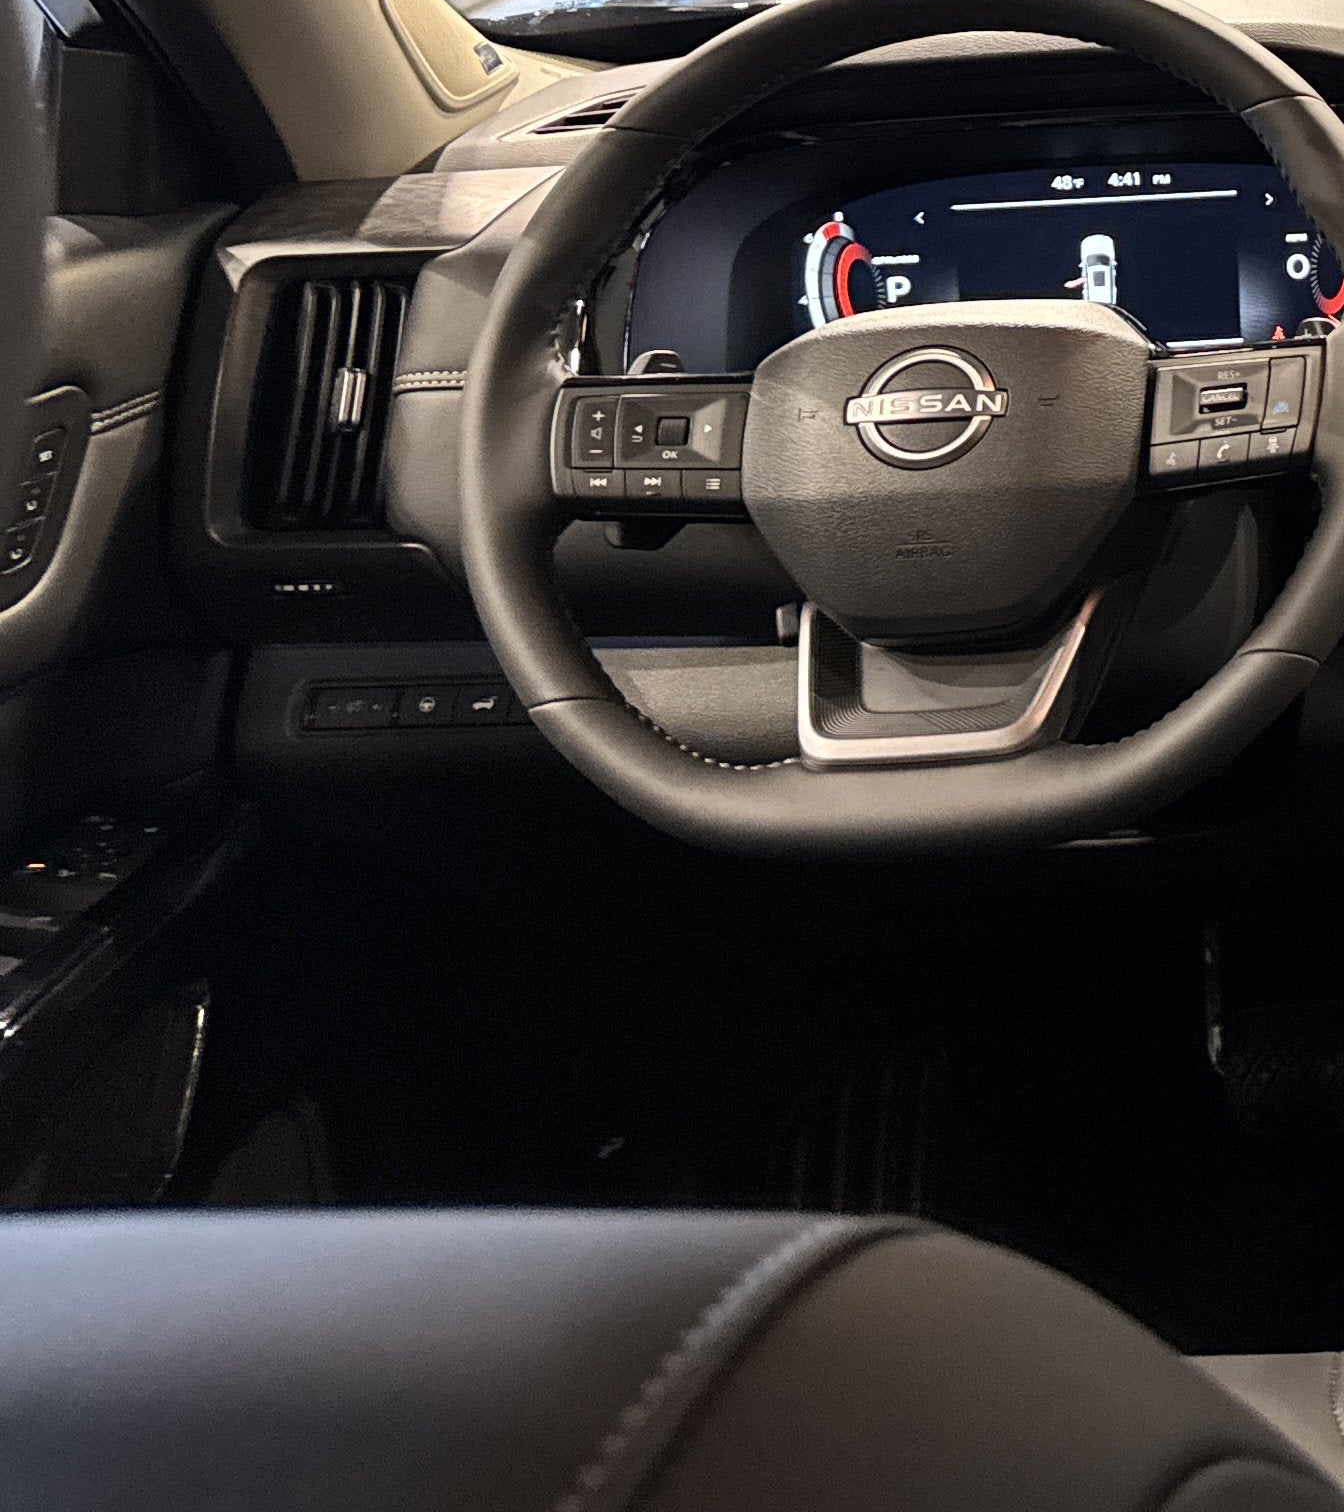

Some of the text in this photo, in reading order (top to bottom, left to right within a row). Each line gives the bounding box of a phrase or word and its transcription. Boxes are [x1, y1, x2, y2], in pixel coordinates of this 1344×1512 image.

[1107, 171, 1171, 187] 4:41 PM
[886, 275, 912, 303] P
[1217, 369, 1242, 381] RES+
[1201, 393, 1241, 403] CANCEL
[852, 393, 1002, 418] NISSAN
[661, 450, 679, 460] OK
